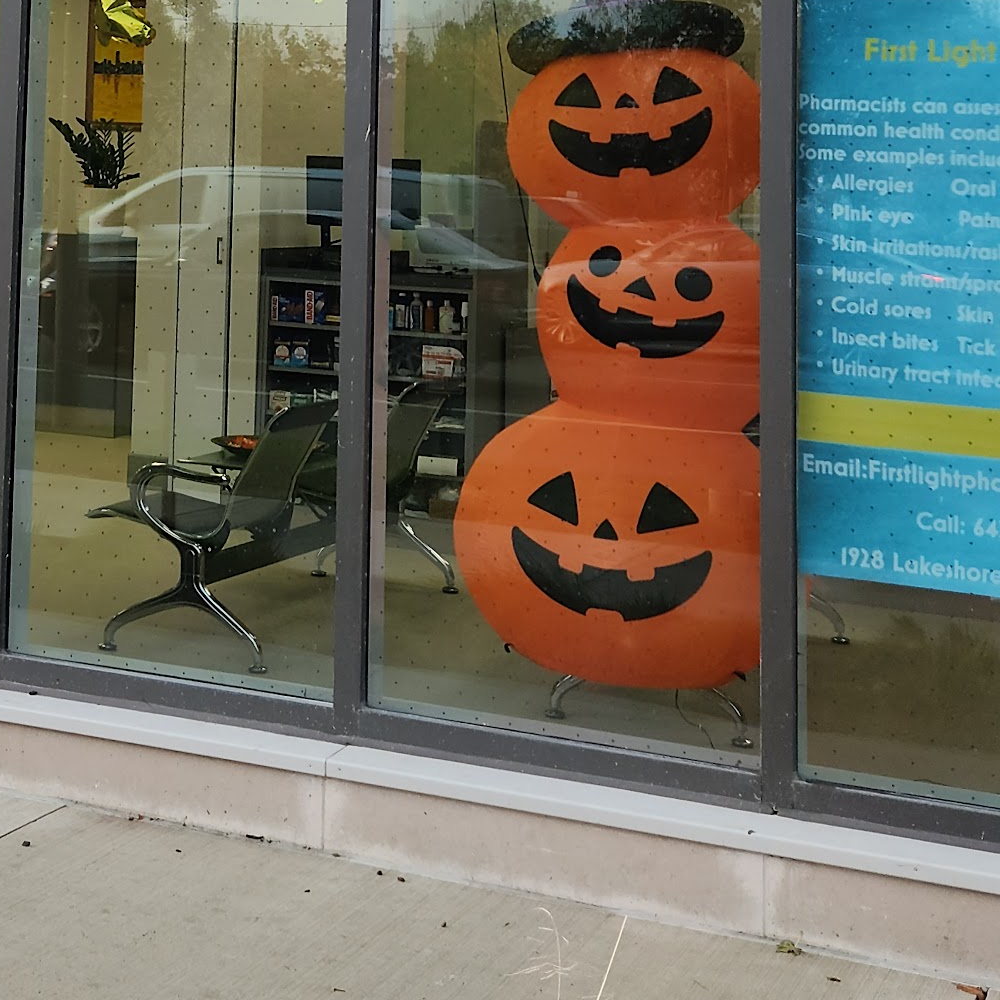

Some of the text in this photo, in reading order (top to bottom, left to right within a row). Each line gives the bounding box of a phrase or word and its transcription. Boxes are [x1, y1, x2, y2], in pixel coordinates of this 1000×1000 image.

[864, 38, 996, 68] First Light
[799, 93, 906, 113] Pharmacists
[912, 100, 947, 114] can
[799, 123, 877, 138] common
[884, 121, 944, 139] health
[799, 143, 847, 162] Some
[853, 148, 944, 168] examples
[832, 174, 914, 195] Allergies
[951, 178, 996, 197] Oral
[832, 203, 914, 227] Pink eye
[959, 209, 1000, 228] Pain
[832, 234, 1000, 260] Skin irritations/ras
[832, 266, 894, 286] Muscle
[831, 296, 932, 319] Cold sores
[957, 305, 994, 325] Skin
[832, 327, 938, 352] Insect bites
[957, 336, 996, 356] Tick
[832, 358, 898, 384] Urinary
[904, 366, 950, 385] tract
[916, 511, 1000, 538] Call: 64
[841, 547, 1000, 584] 1928 Lakeshore
